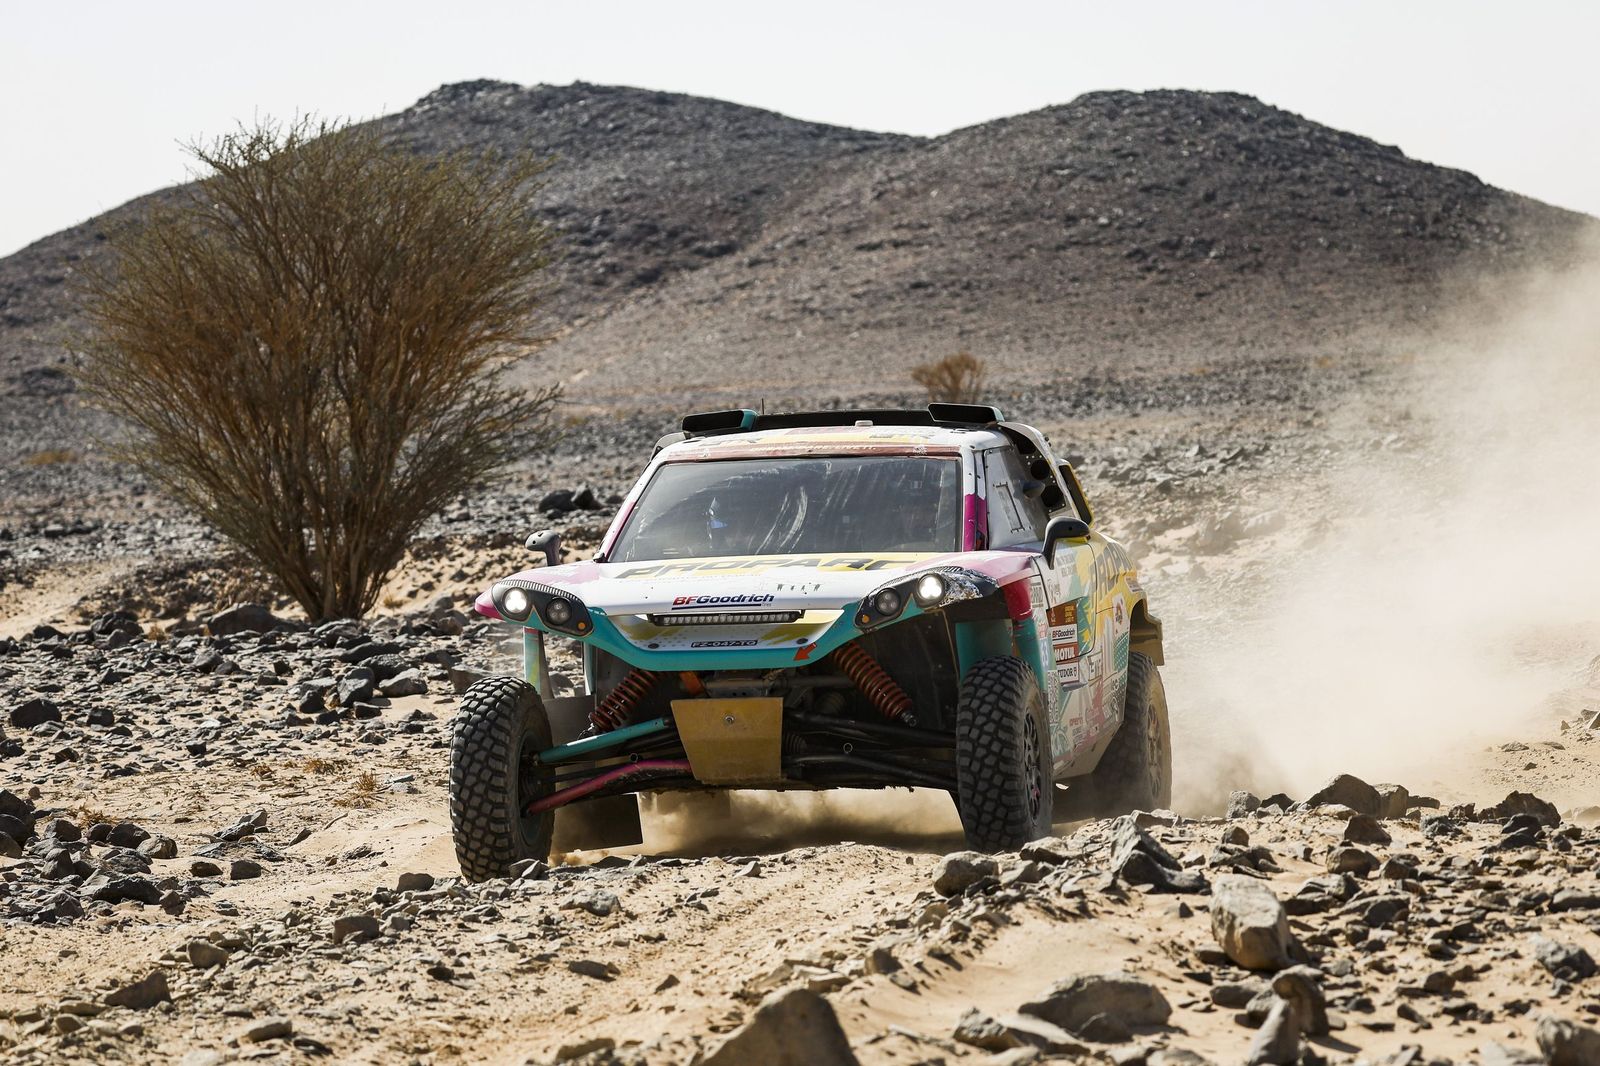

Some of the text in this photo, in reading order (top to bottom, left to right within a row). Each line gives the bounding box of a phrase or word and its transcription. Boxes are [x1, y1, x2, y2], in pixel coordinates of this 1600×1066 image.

[615, 558, 917, 579] PROPARC
[672, 593, 775, 606] BFGoodrich
[1052, 628, 1075, 639] BFGoodrich
[1054, 646, 1075, 661] MOTUL
[1057, 667, 1073, 678] TUDOR
